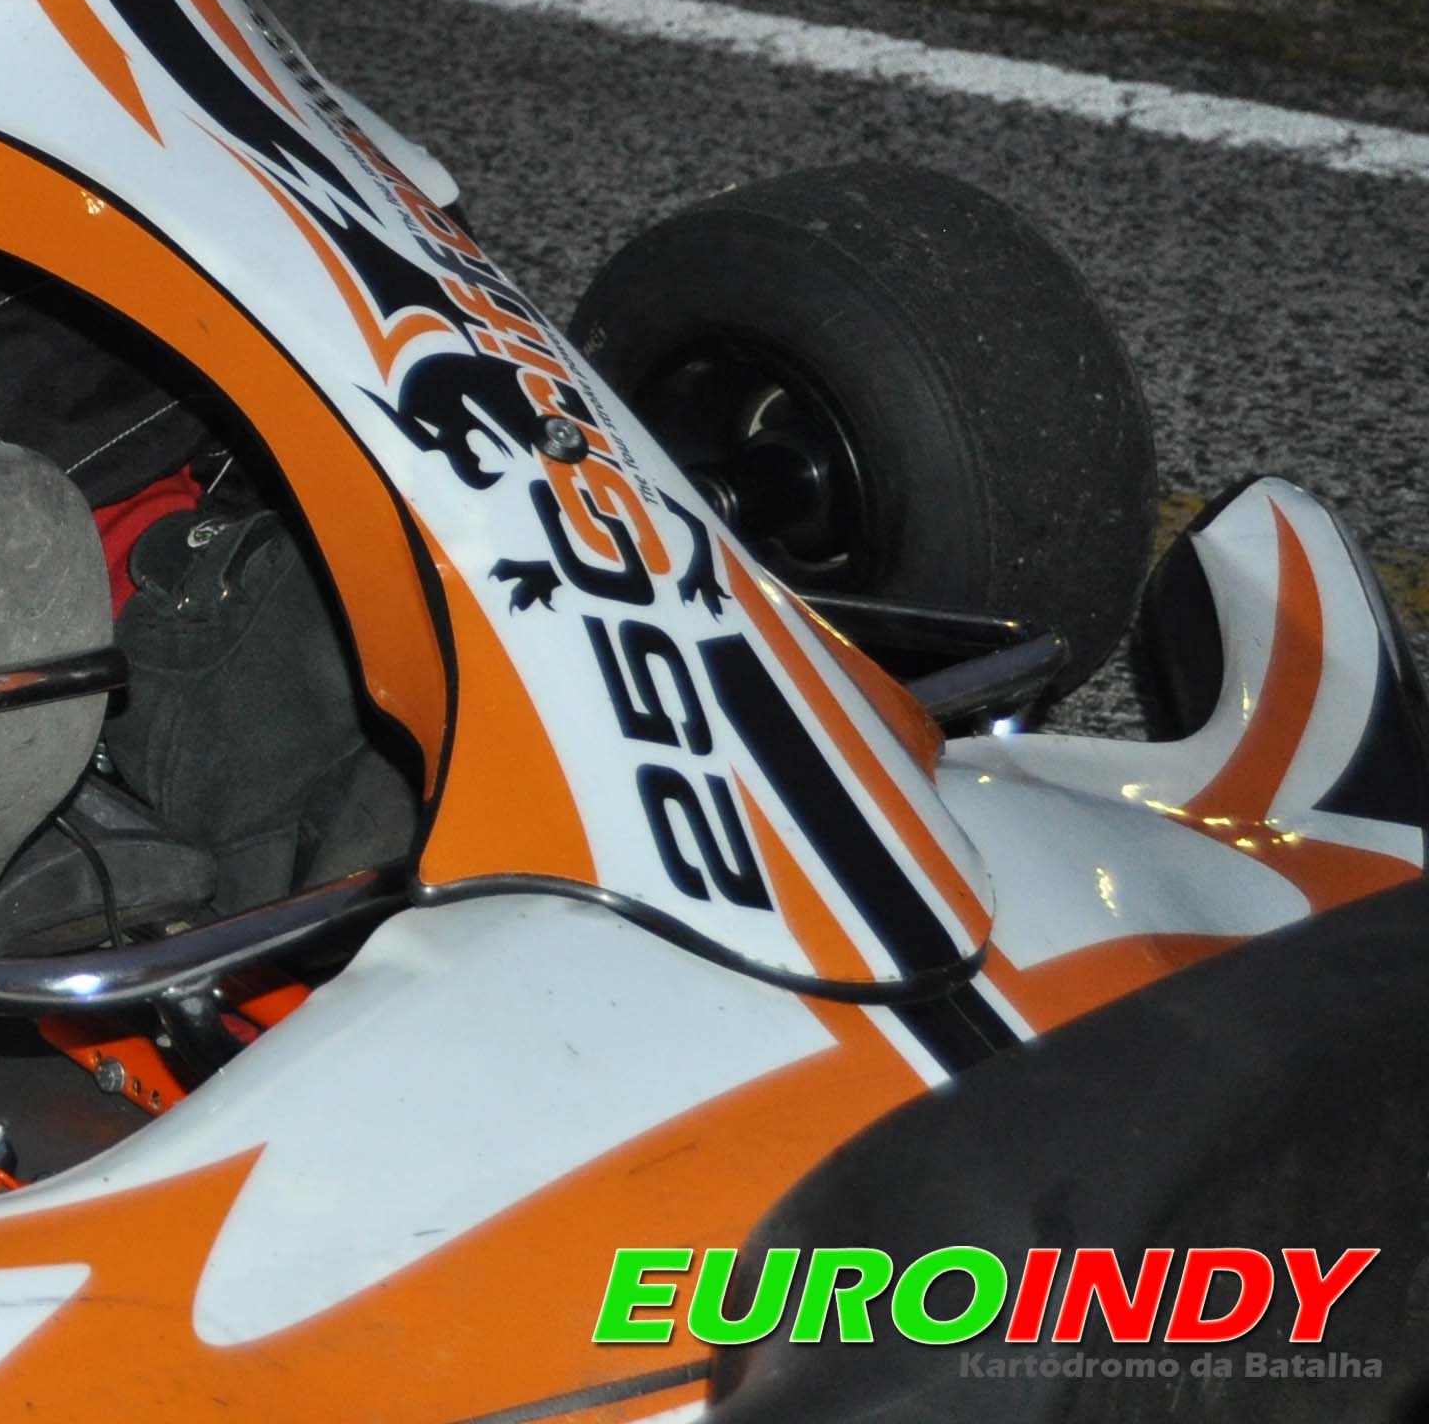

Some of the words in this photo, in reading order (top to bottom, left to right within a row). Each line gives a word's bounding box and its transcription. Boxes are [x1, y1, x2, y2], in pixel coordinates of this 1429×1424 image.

[612, 432, 639, 471] four
[633, 473, 658, 505] The
[581, 612, 775, 913] 25
